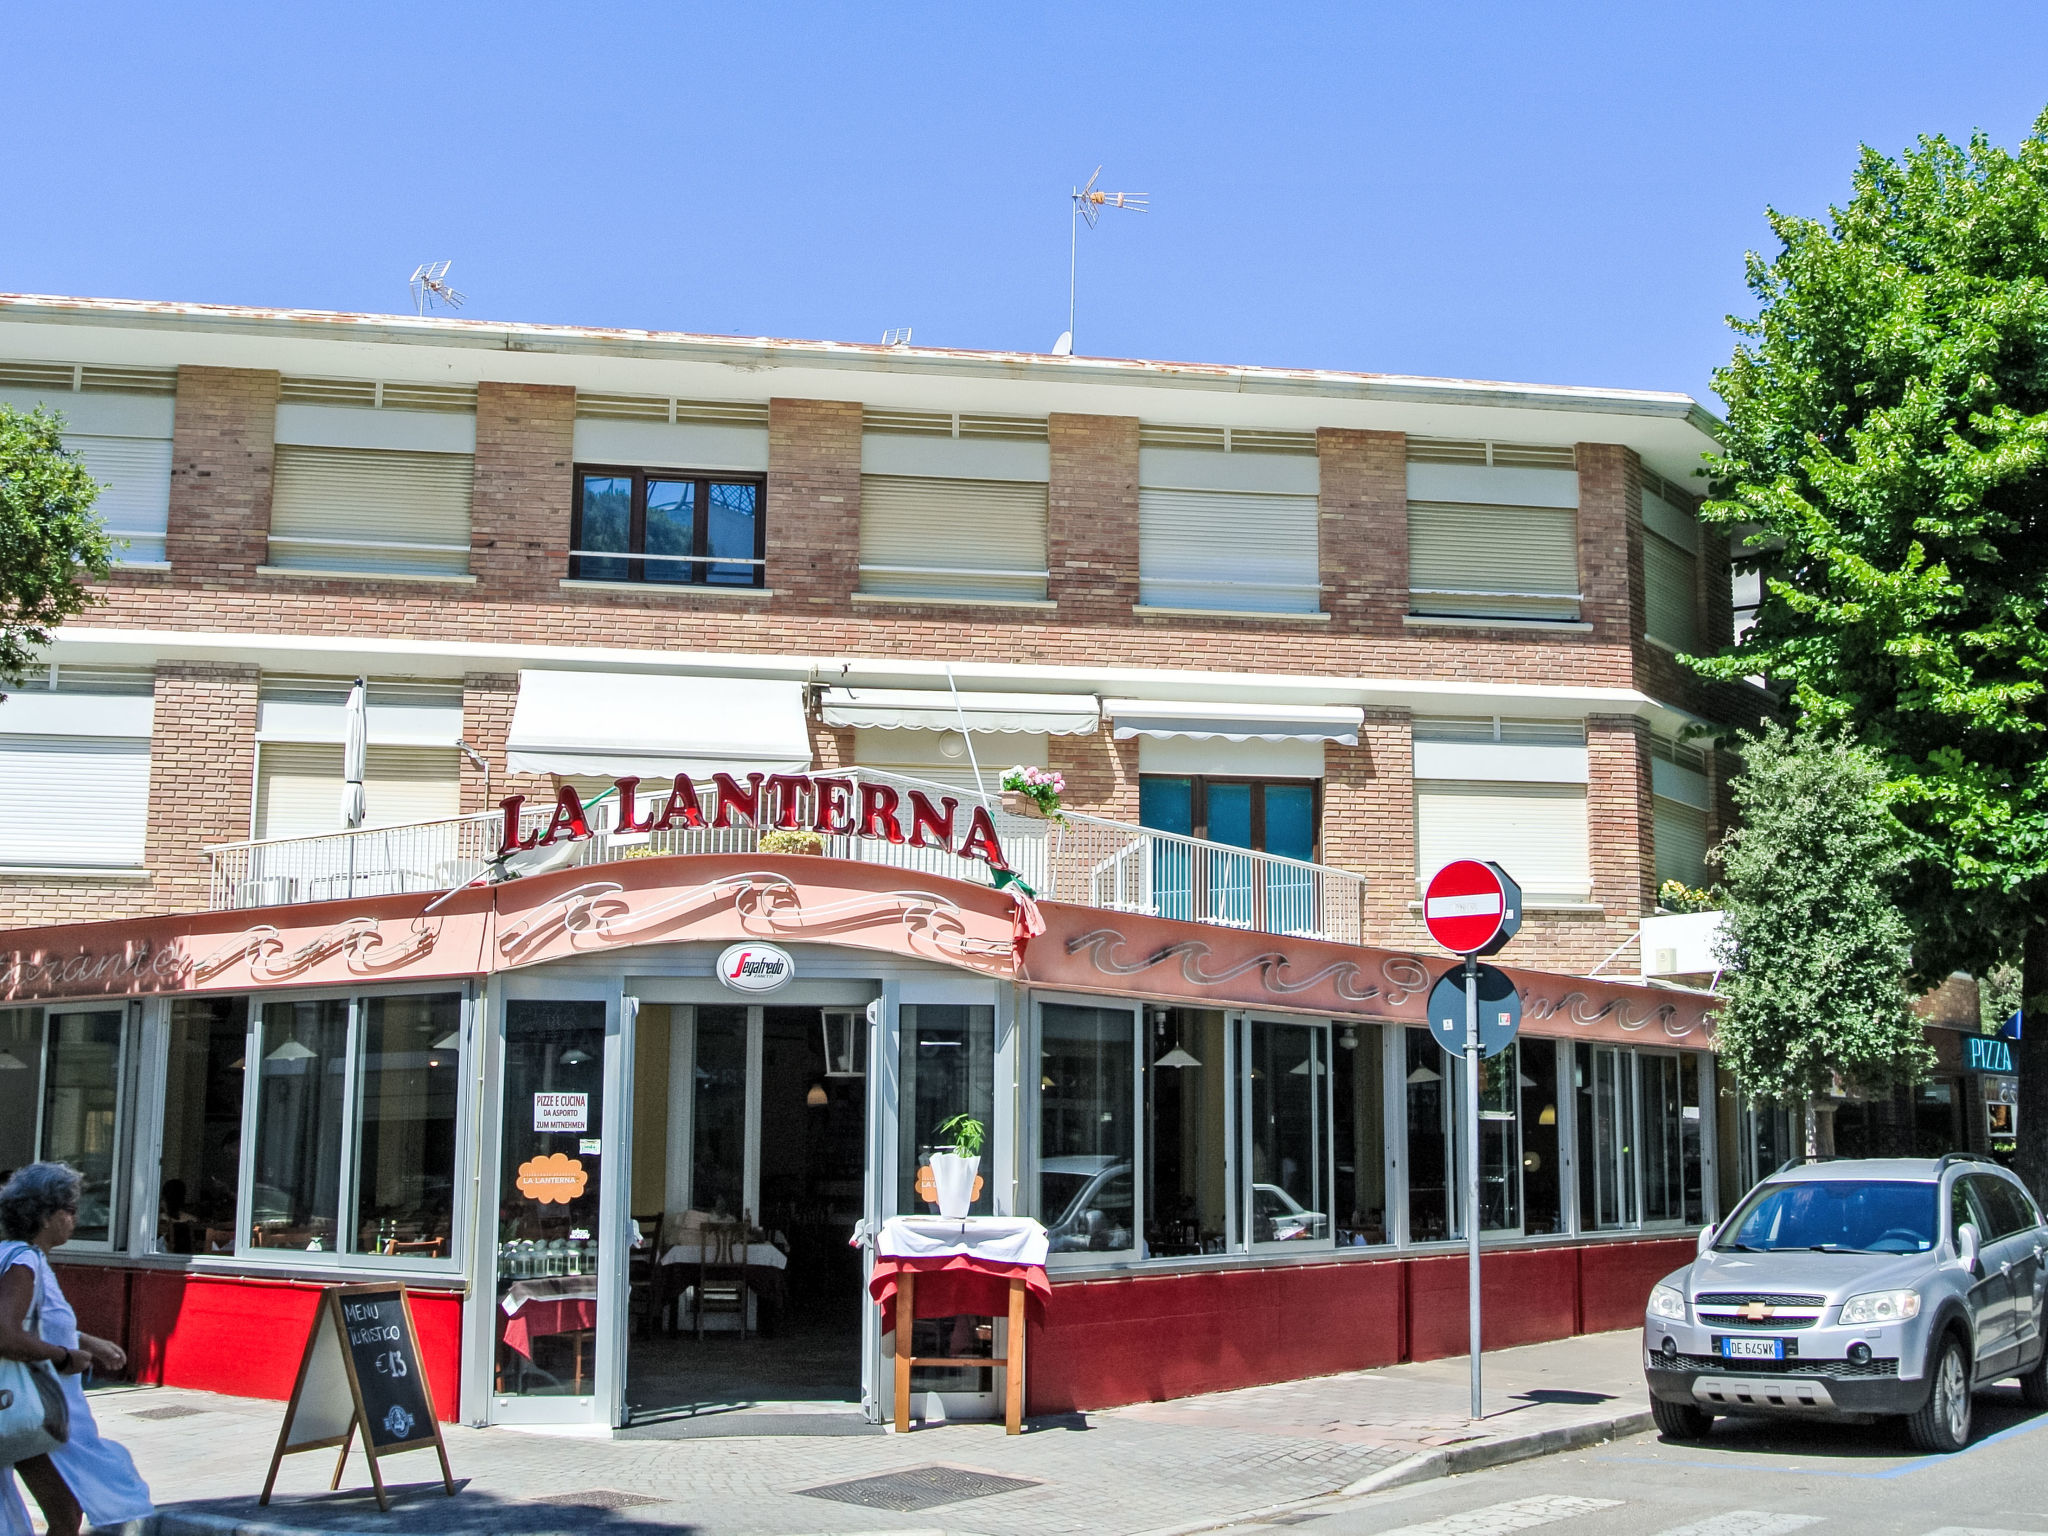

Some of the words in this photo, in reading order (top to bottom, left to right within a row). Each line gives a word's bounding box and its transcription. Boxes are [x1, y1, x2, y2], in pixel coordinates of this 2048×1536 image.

[498, 785, 594, 855] LA
[613, 773, 1009, 870] LANTERNA
[730, 953, 784, 978] Segafredo
[1971, 1038, 2012, 1071] PIZZA
[536, 1095, 554, 1107] PIZZE
[555, 1095, 560, 1107] E
[561, 1095, 586, 1107] CUCINA
[543, 1109, 551, 1117] DA
[552, 1109, 578, 1117] ASPORTO
[536, 1121, 549, 1129] ZUM
[550, 1121, 585, 1129] MITNEHMEN
[344, 1303, 379, 1322] MENU
[348, 1325, 400, 1346] TURISTICO
[1731, 1342, 1742, 1354] DE
